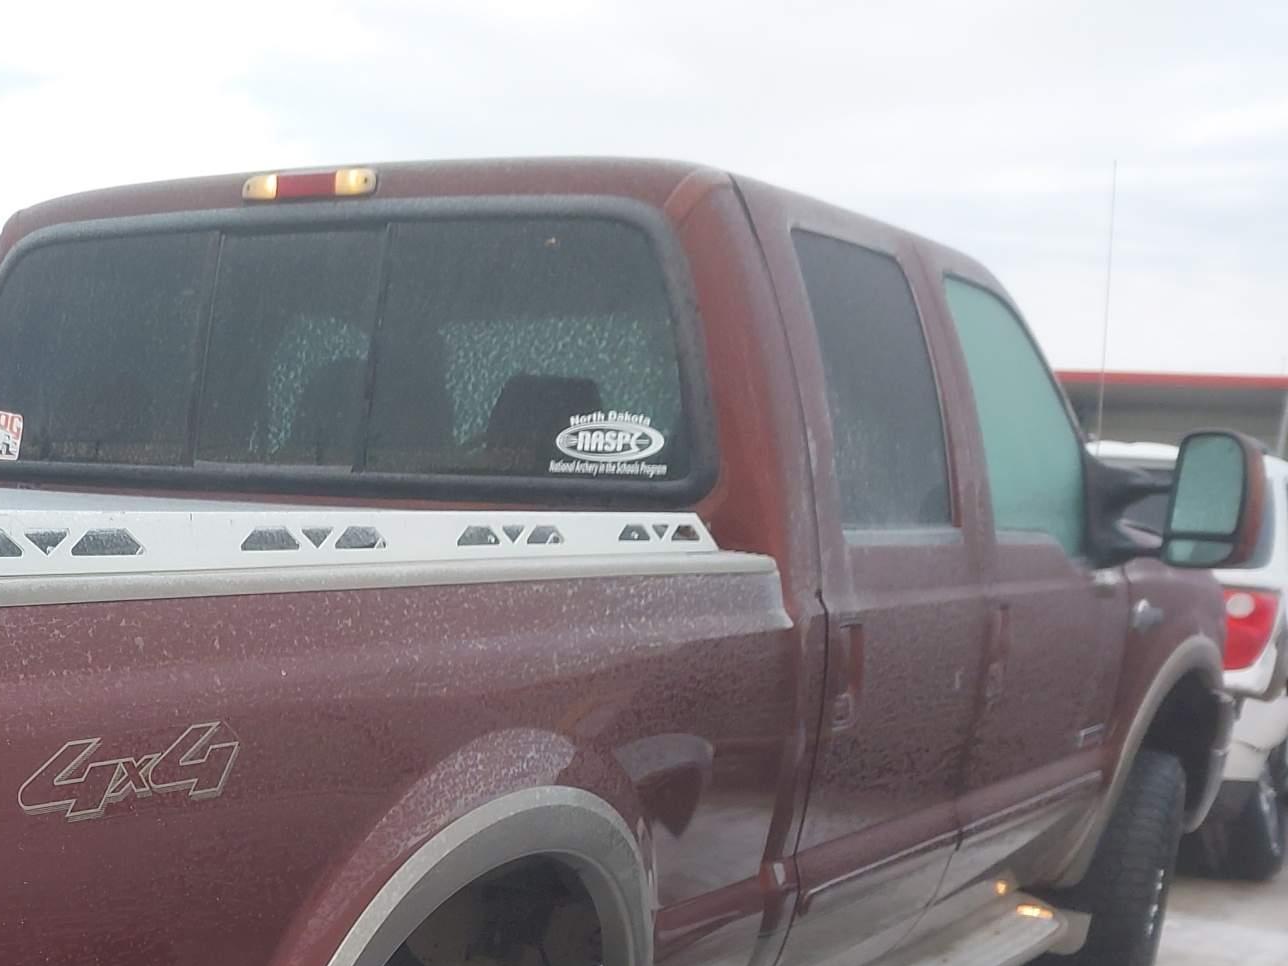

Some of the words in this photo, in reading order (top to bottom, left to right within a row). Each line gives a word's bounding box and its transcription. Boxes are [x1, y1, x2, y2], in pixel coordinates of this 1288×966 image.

[570, 411, 605, 426] North
[608, 410, 651, 427] Dakota
[549, 460, 576, 473] National
[575, 461, 599, 476] Archery
[616, 463, 640, 474] Schools
[639, 462, 667, 478] Program
[18, 721, 240, 822] 4x4
